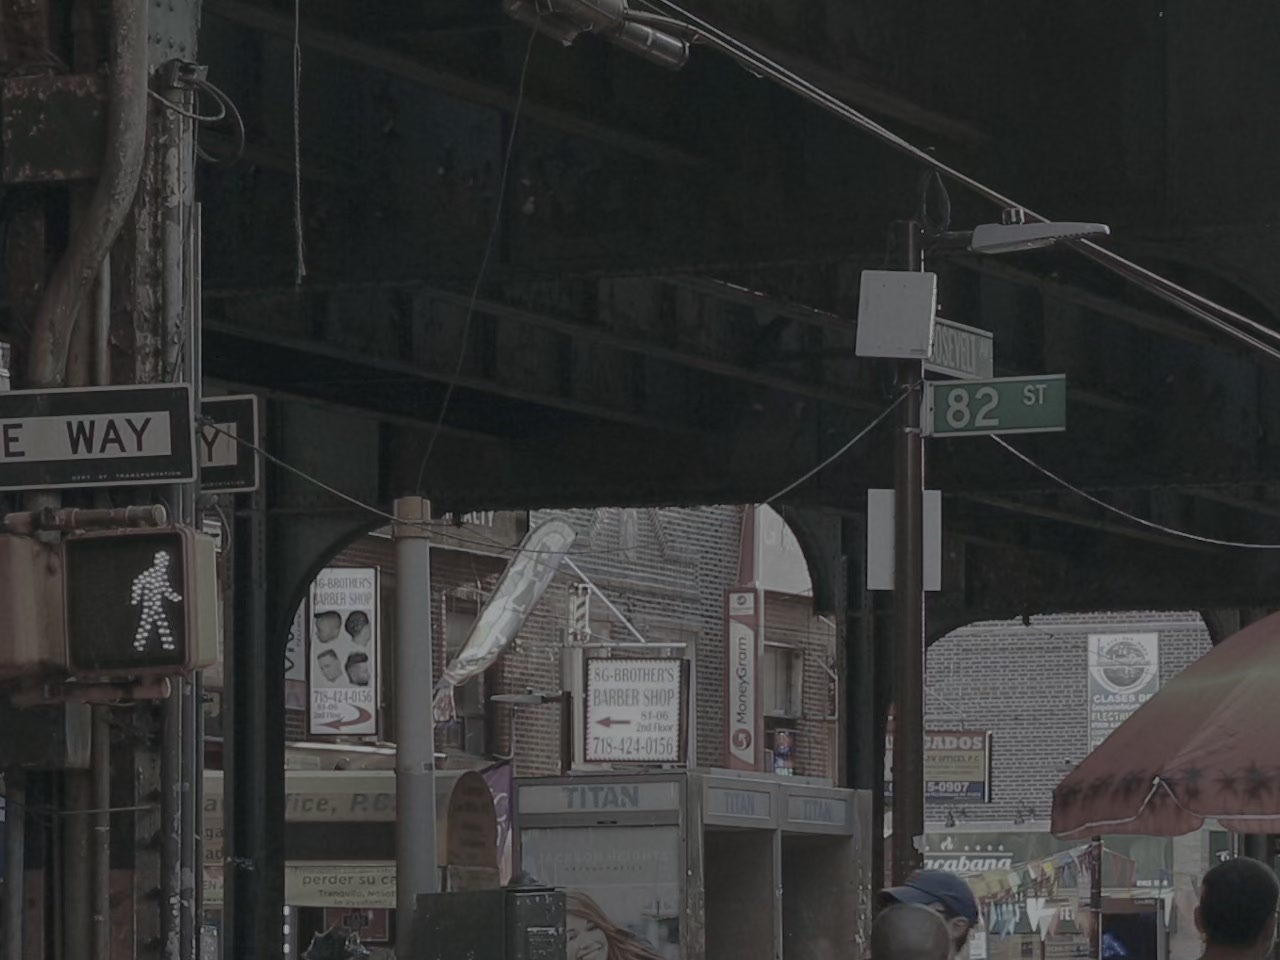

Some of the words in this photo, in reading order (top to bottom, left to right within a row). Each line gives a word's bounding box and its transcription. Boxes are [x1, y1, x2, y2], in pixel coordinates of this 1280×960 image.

[929, 325, 976, 373] OSEVELT
[946, 387, 1000, 429] 82
[1024, 384, 1048, 406] ST
[66, 417, 152, 455] WAY
[736, 636, 748, 725] MoneyGram
[593, 687, 640, 708] BARBER
[643, 687, 675, 708] SHOP
[561, 785, 640, 809] TITAN
[724, 792, 756, 816] TITAN
[302, 875, 354, 887] perder
[359, 876, 376, 885] su
